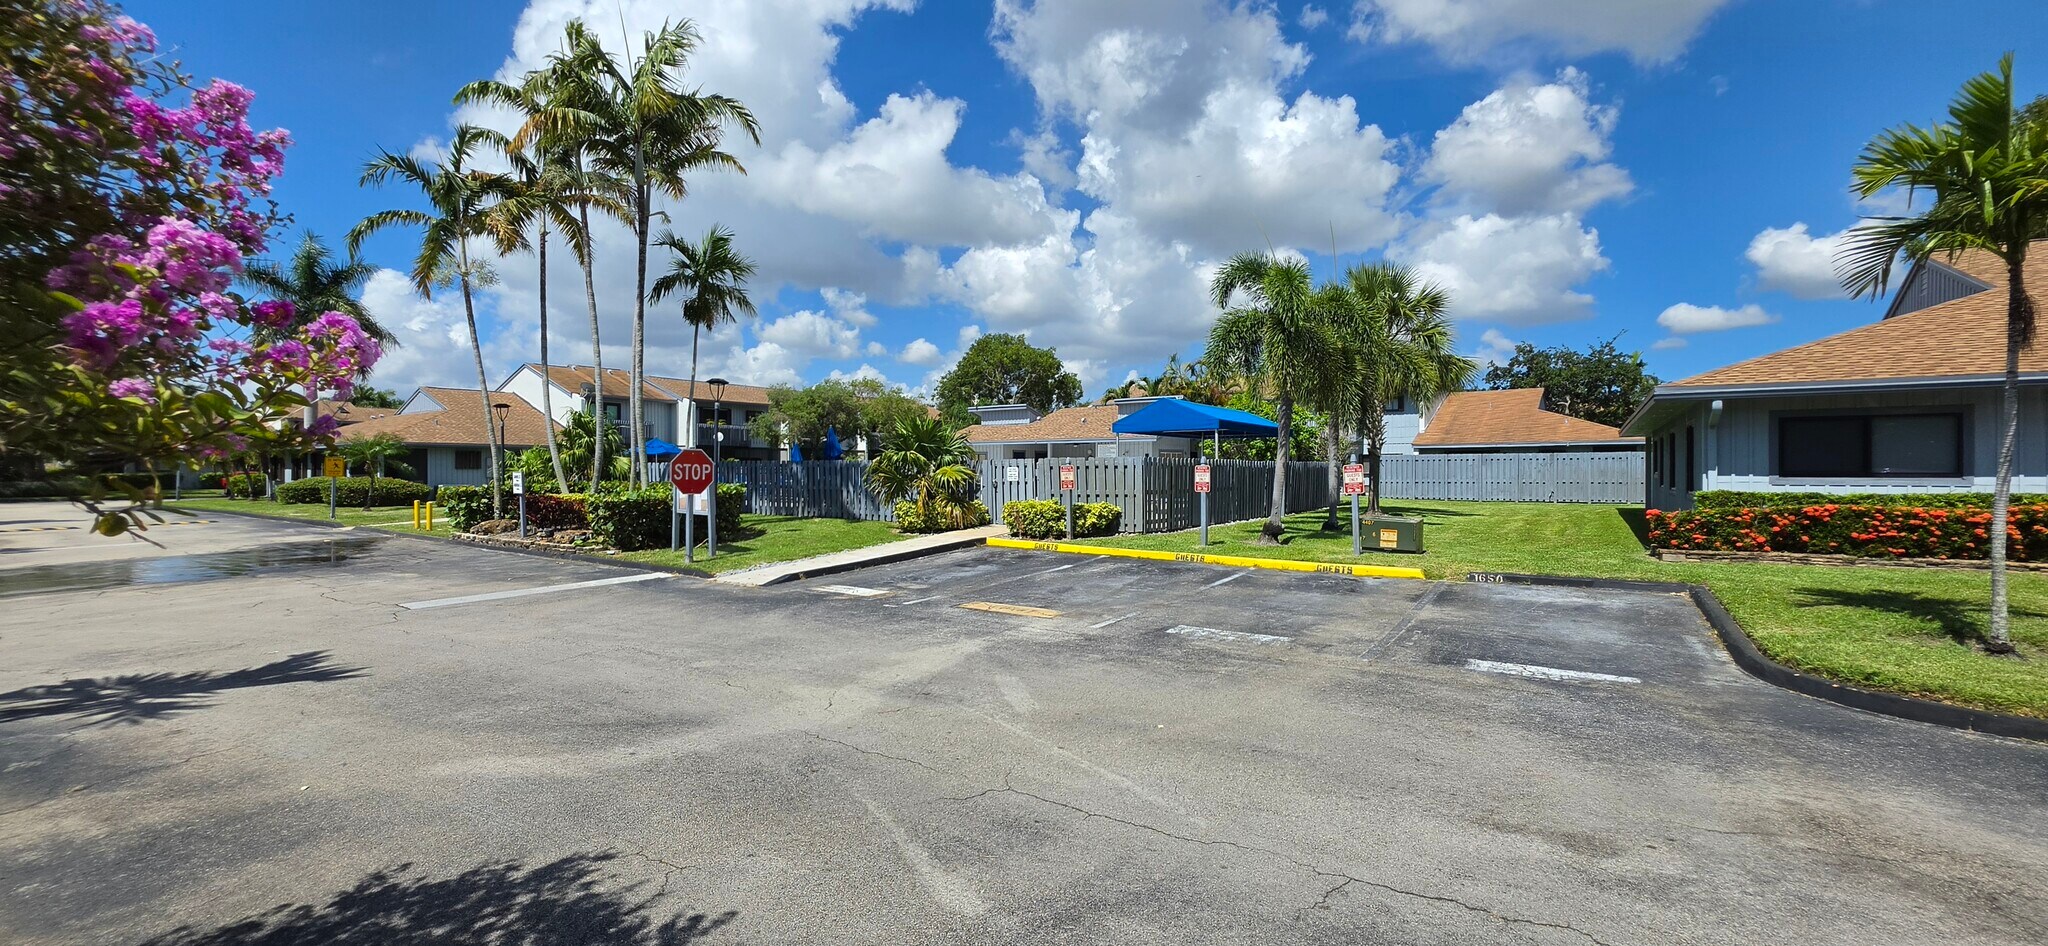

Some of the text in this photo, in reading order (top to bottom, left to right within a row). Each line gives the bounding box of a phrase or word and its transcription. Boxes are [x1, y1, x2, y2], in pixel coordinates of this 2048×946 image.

[674, 463, 711, 480] STOP
[1034, 543, 1059, 551] GUESTS
[1175, 553, 1206, 562] GUESTS
[1316, 564, 1353, 575] GUESTS
[1474, 573, 1504, 583] 1650
